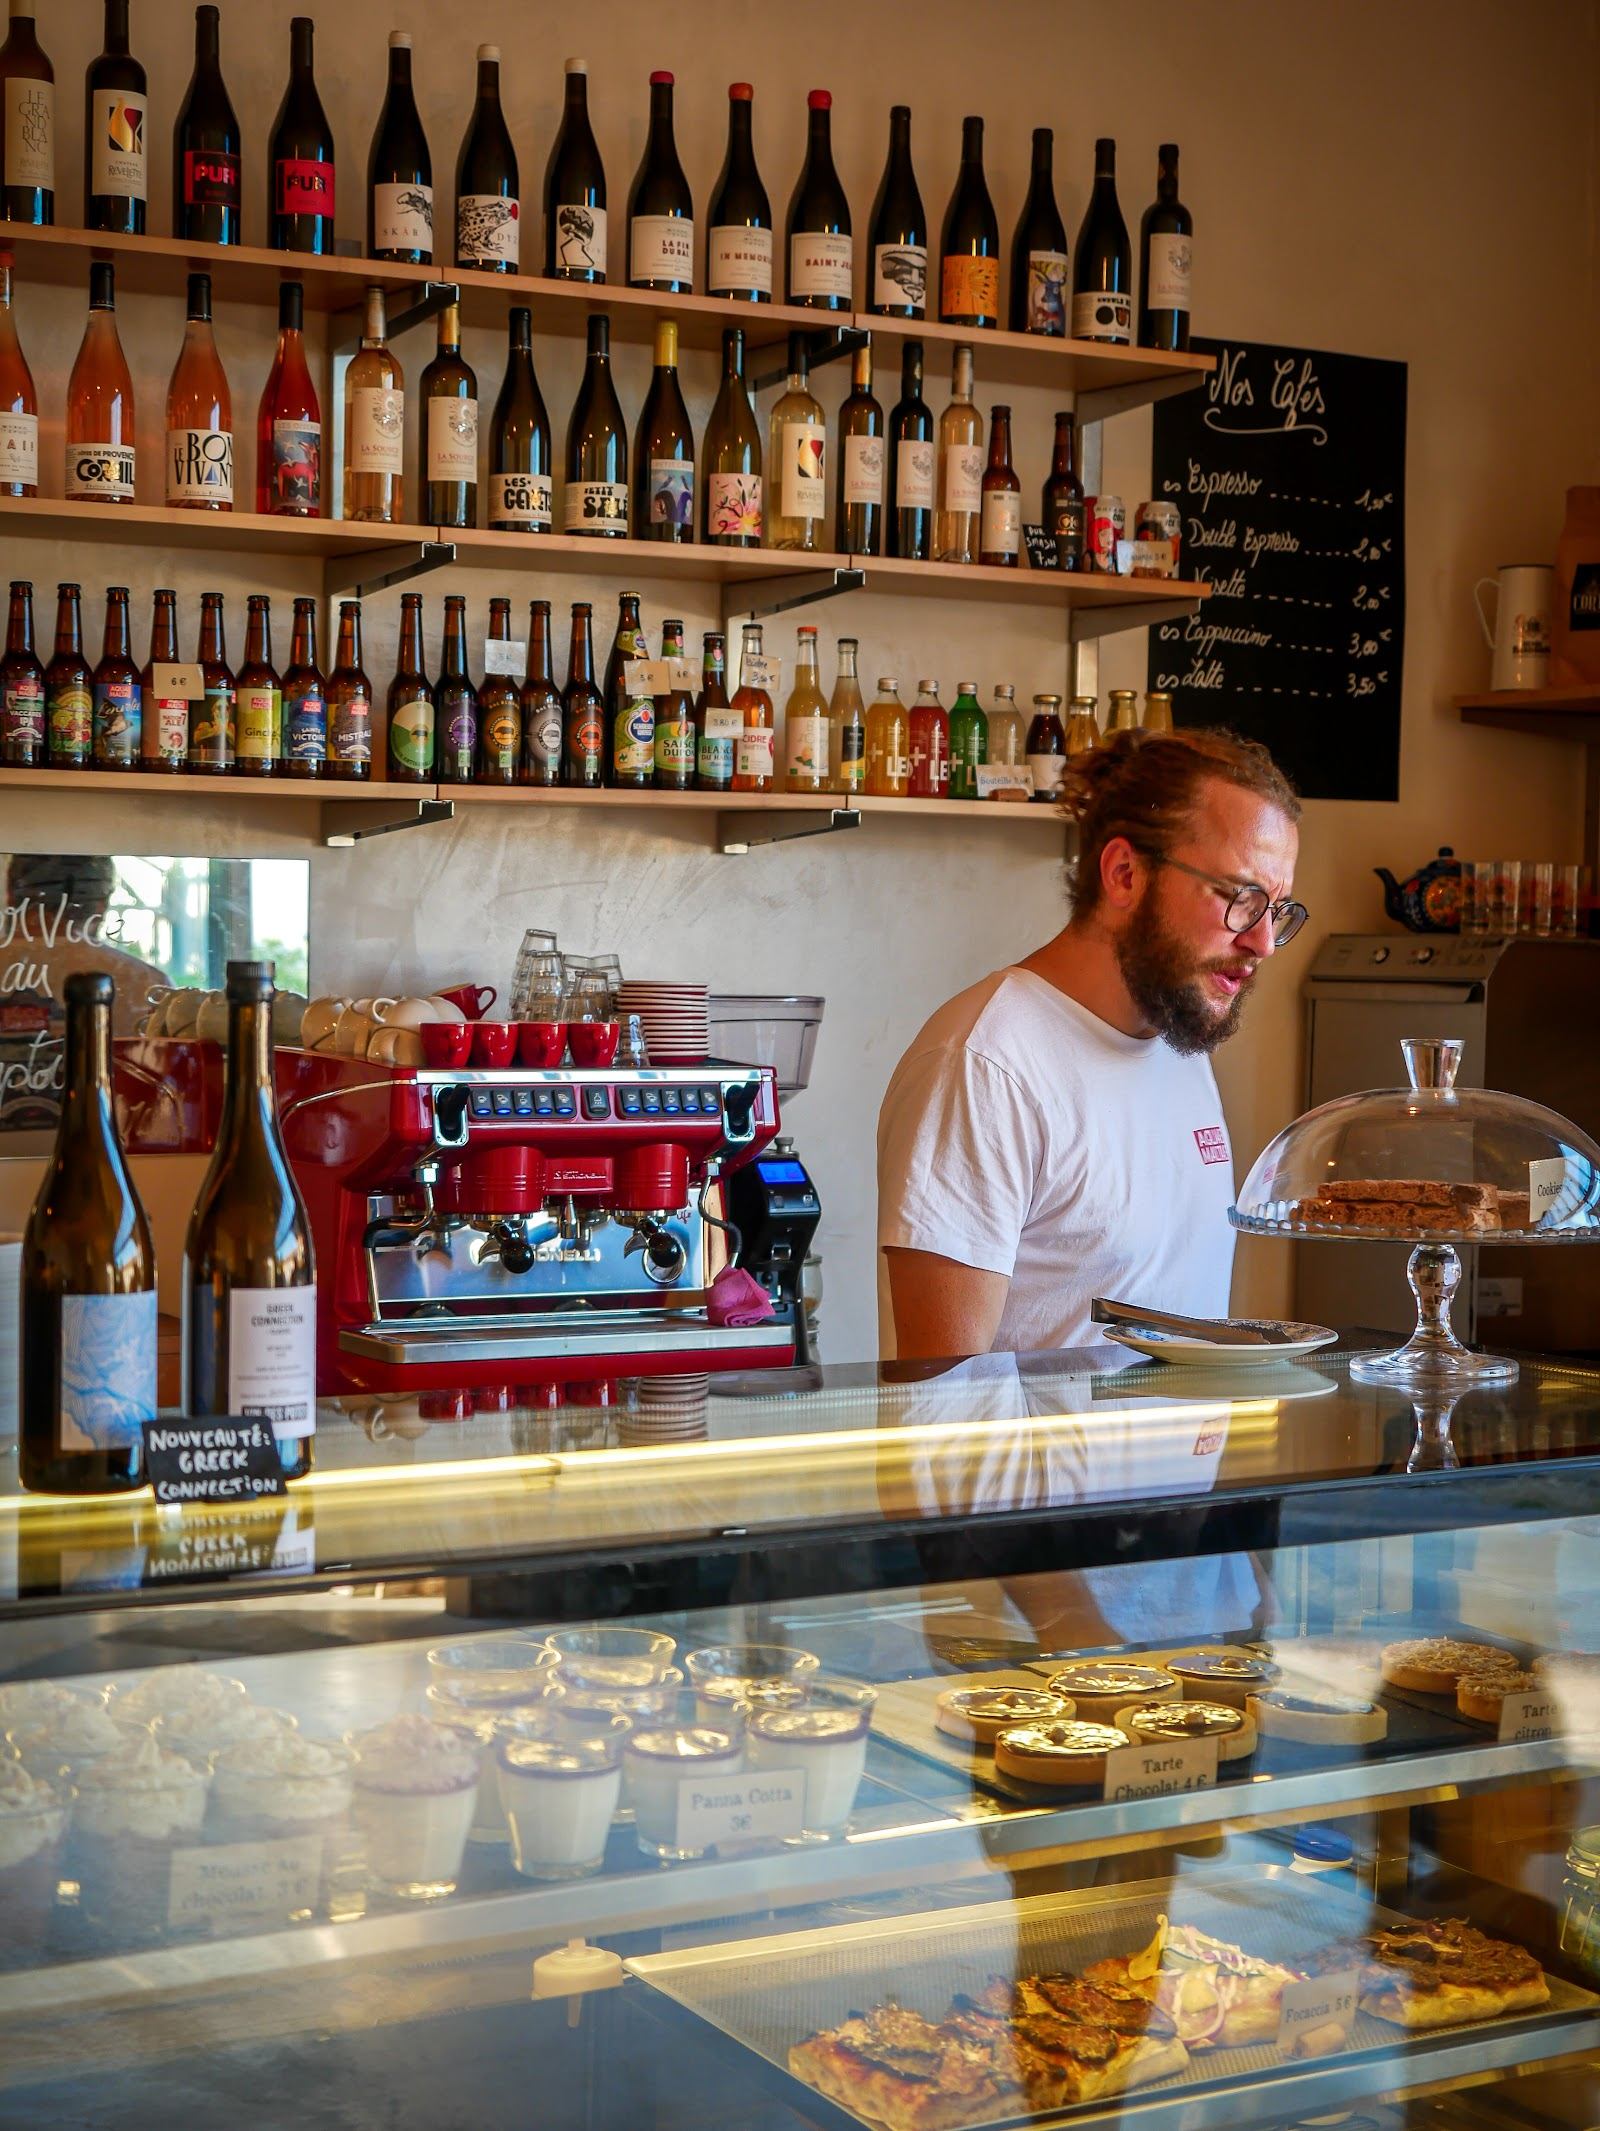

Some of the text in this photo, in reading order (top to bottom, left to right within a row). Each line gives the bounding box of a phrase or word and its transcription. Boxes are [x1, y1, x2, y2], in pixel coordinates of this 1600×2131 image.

[195, 163, 235, 185] PUR
[286, 175, 326, 193] PUR
[806, 259, 838, 267] SAINT
[1209, 347, 1254, 407] Nos
[1188, 458, 1262, 513] Espresso
[1188, 517, 1237, 548] Double
[1243, 527, 1300, 568] Espresso
[1185, 614, 1272, 657] Cappuccino
[171, 677, 187, 686] 6 €
[20, 717, 34, 727] IPA
[743, 735, 767, 743] CIDRE
[179, 1449, 249, 1474] GREEK
[1522, 1704, 1558, 1719] Tarte
[1143, 1757, 1183, 1774] Tarte
[692, 1788, 793, 1810] Panna Cotta
[1115, 1779, 1178, 1801] Chocolat
